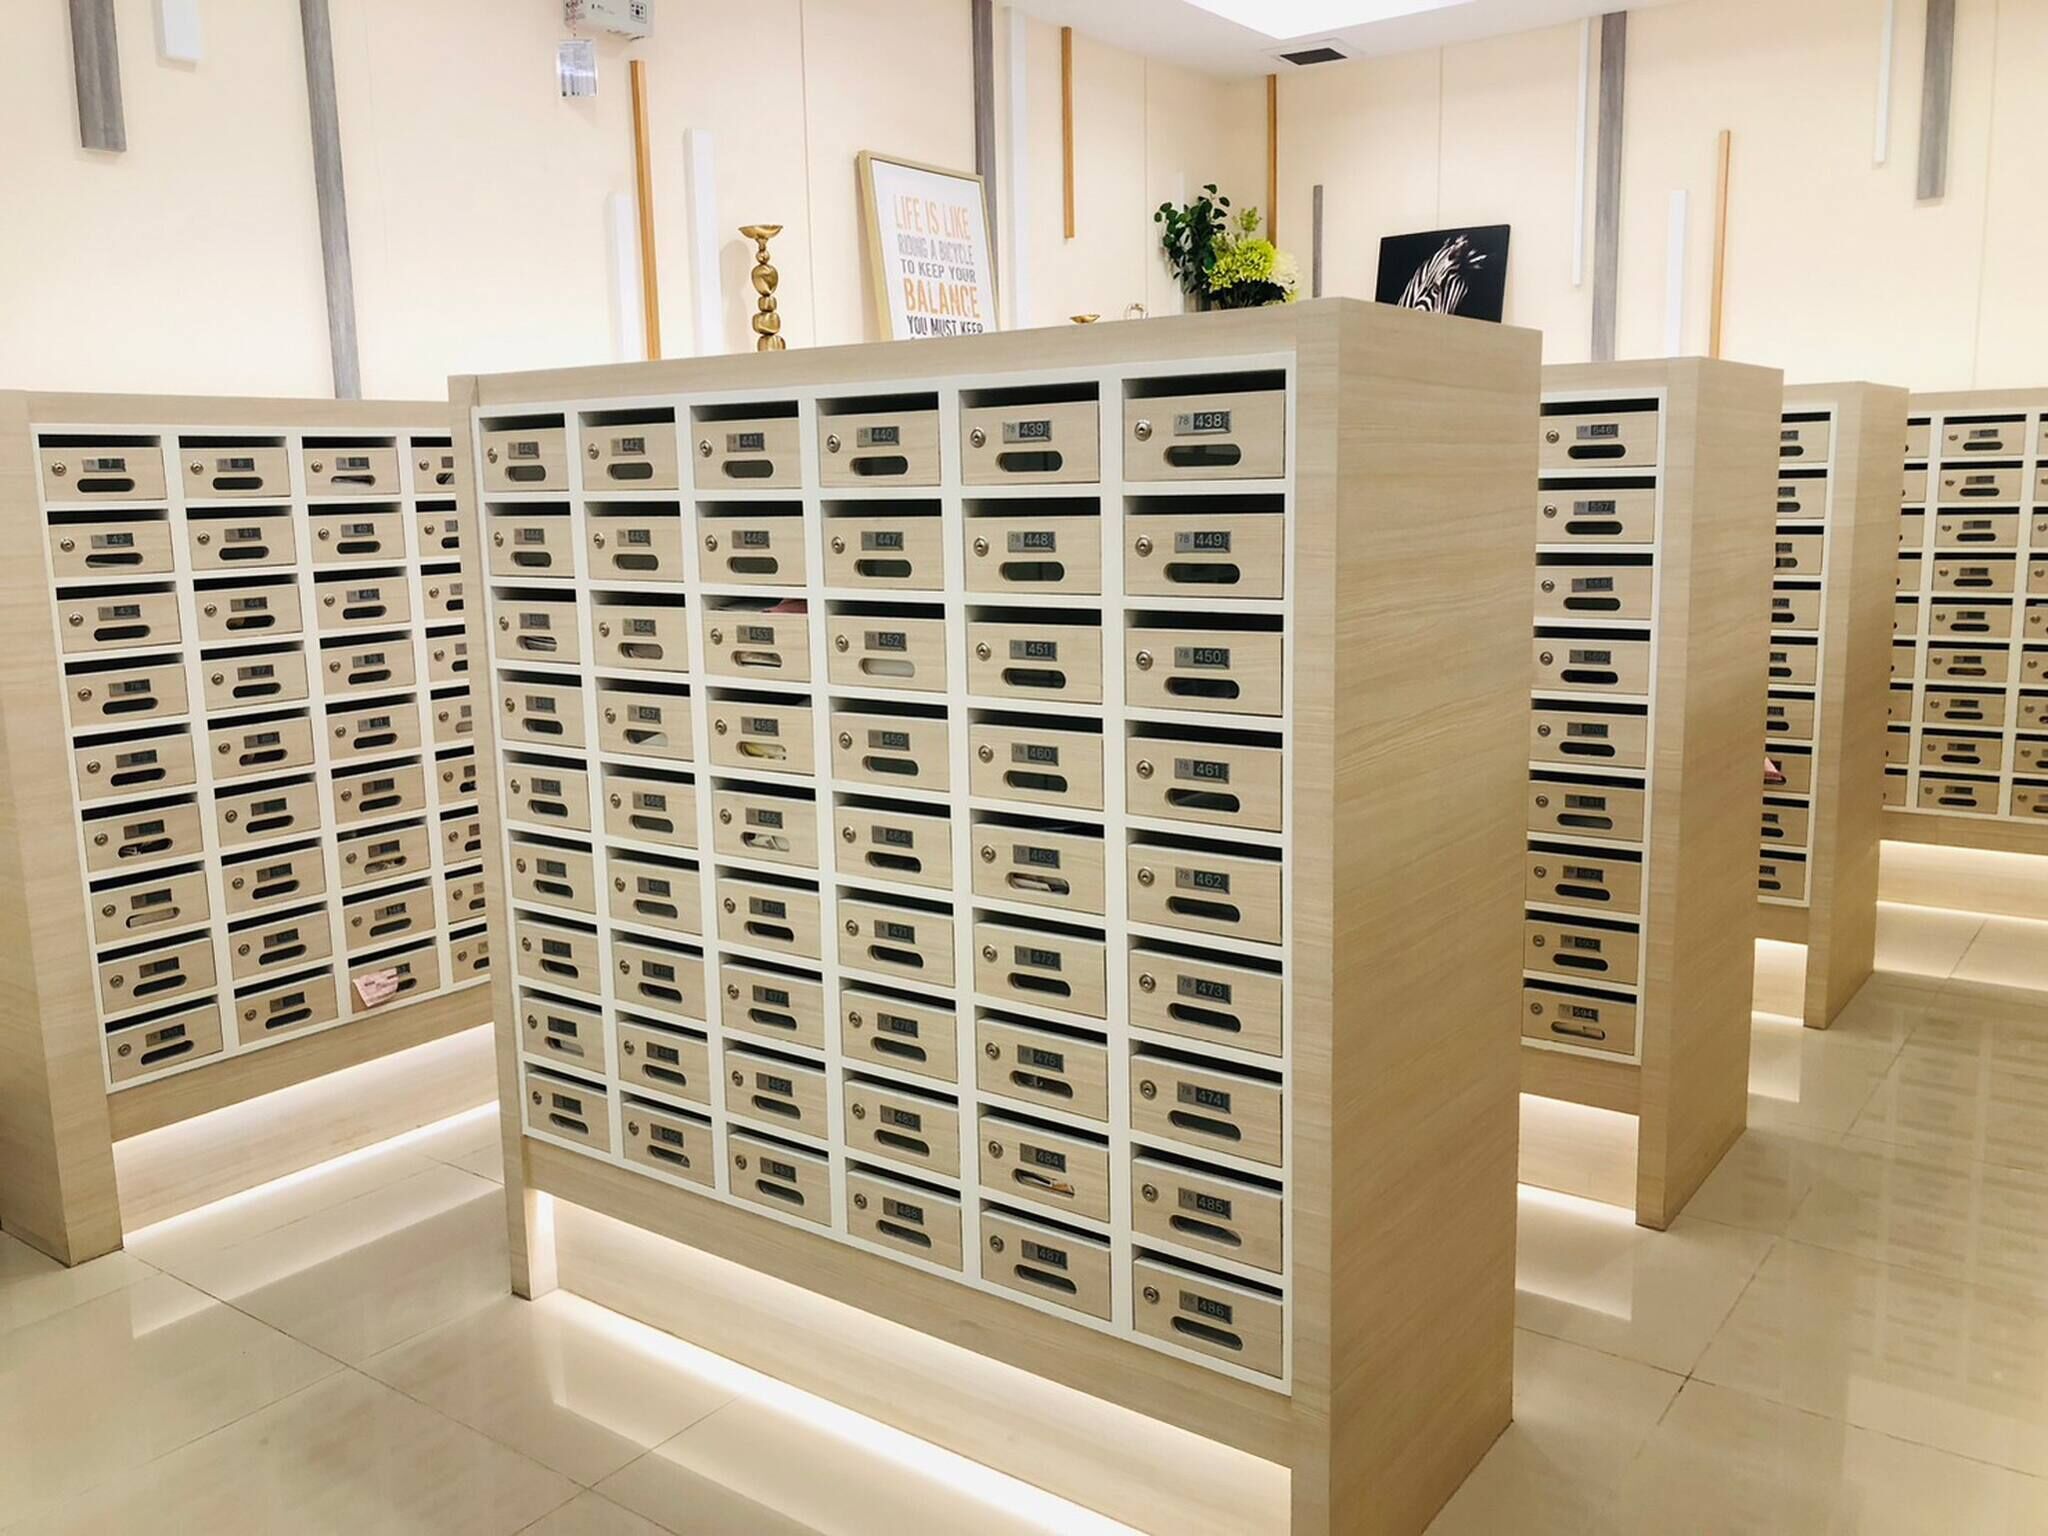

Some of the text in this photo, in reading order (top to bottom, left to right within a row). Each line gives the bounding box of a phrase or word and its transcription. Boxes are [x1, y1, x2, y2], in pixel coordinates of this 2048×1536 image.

[893, 194, 972, 240] LIFE IS LIKE
[897, 233, 974, 265] RIDING A BICYCLE
[900, 259, 976, 284] TO KEEP YOUR
[903, 277, 980, 318] BALANCE
[907, 315, 928, 336] YOU
[930, 317, 958, 336] MUST
[1178, 413, 1222, 428] 78 438
[874, 428, 893, 440] 440
[1020, 423, 1044, 436] 439
[625, 440, 641, 450] 442
[741, 434, 758, 445] 441
[519, 444, 535, 454] 443
[630, 531, 646, 541] 445
[746, 533, 763, 543] 446
[879, 534, 897, 545] 447
[1025, 533, 1048, 546] 448
[1178, 534, 1222, 546] 78 449
[635, 620, 651, 631] 454
[751, 628, 768, 639] 453
[880, 634, 900, 646] 452
[1028, 643, 1049, 655] 451
[1195, 650, 1222, 663] 450
[641, 708, 657, 719] 457
[884, 733, 904, 745] 459
[1029, 746, 1052, 759] 460
[1196, 763, 1220, 776] 461
[1031, 848, 1053, 862] 463
[1196, 873, 1222, 887] 462
[1032, 951, 1054, 964] 472
[1197, 982, 1223, 997] 473
[1198, 1090, 1222, 1106] 474
[1038, 1151, 1059, 1165] 484
[1199, 1197, 1223, 1212] 485
[1039, 1249, 1061, 1262] 487
[1200, 1300, 1224, 1317] 486
